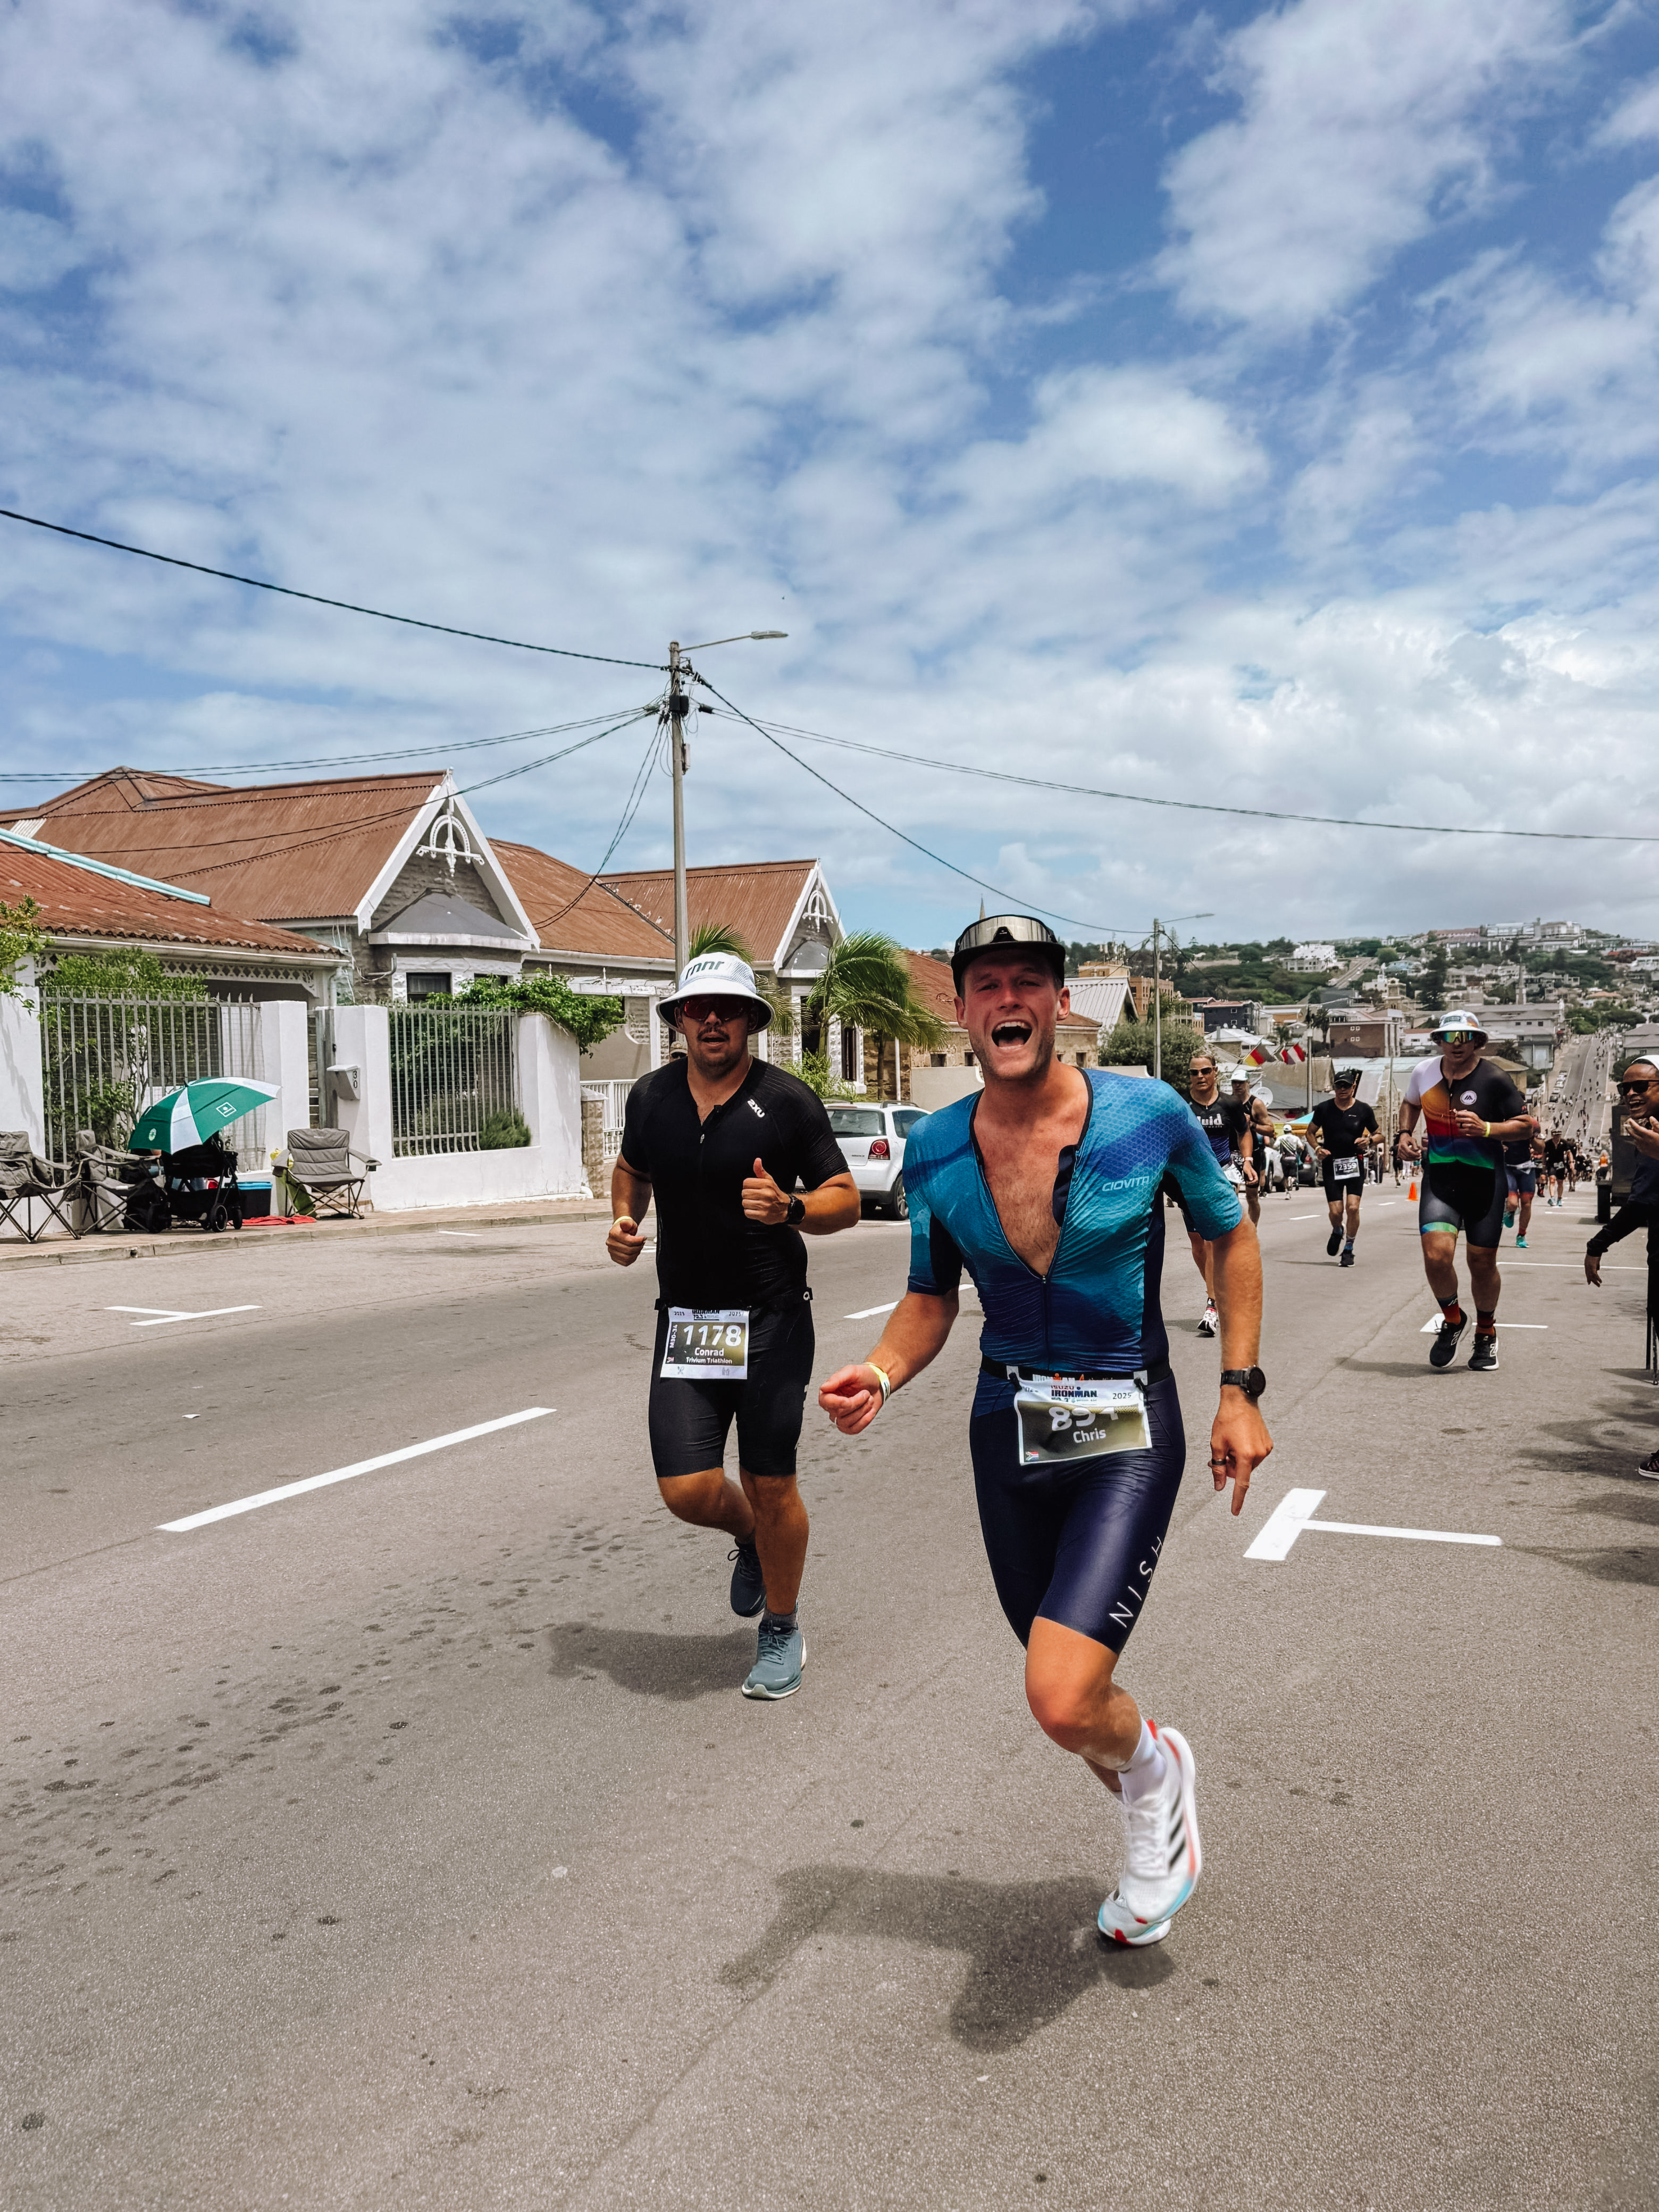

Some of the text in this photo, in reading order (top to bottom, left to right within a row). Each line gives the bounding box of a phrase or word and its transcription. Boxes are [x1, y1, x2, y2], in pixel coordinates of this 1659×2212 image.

[353, 1070, 358, 1088] 30
[747, 1099, 765, 1118] 2XU
[1102, 1176, 1150, 1192] CIOVITA
[683, 1325, 742, 1347] 1178
[694, 1347, 724, 1356] Conrad
[1073, 1428, 1107, 1443] Chris
